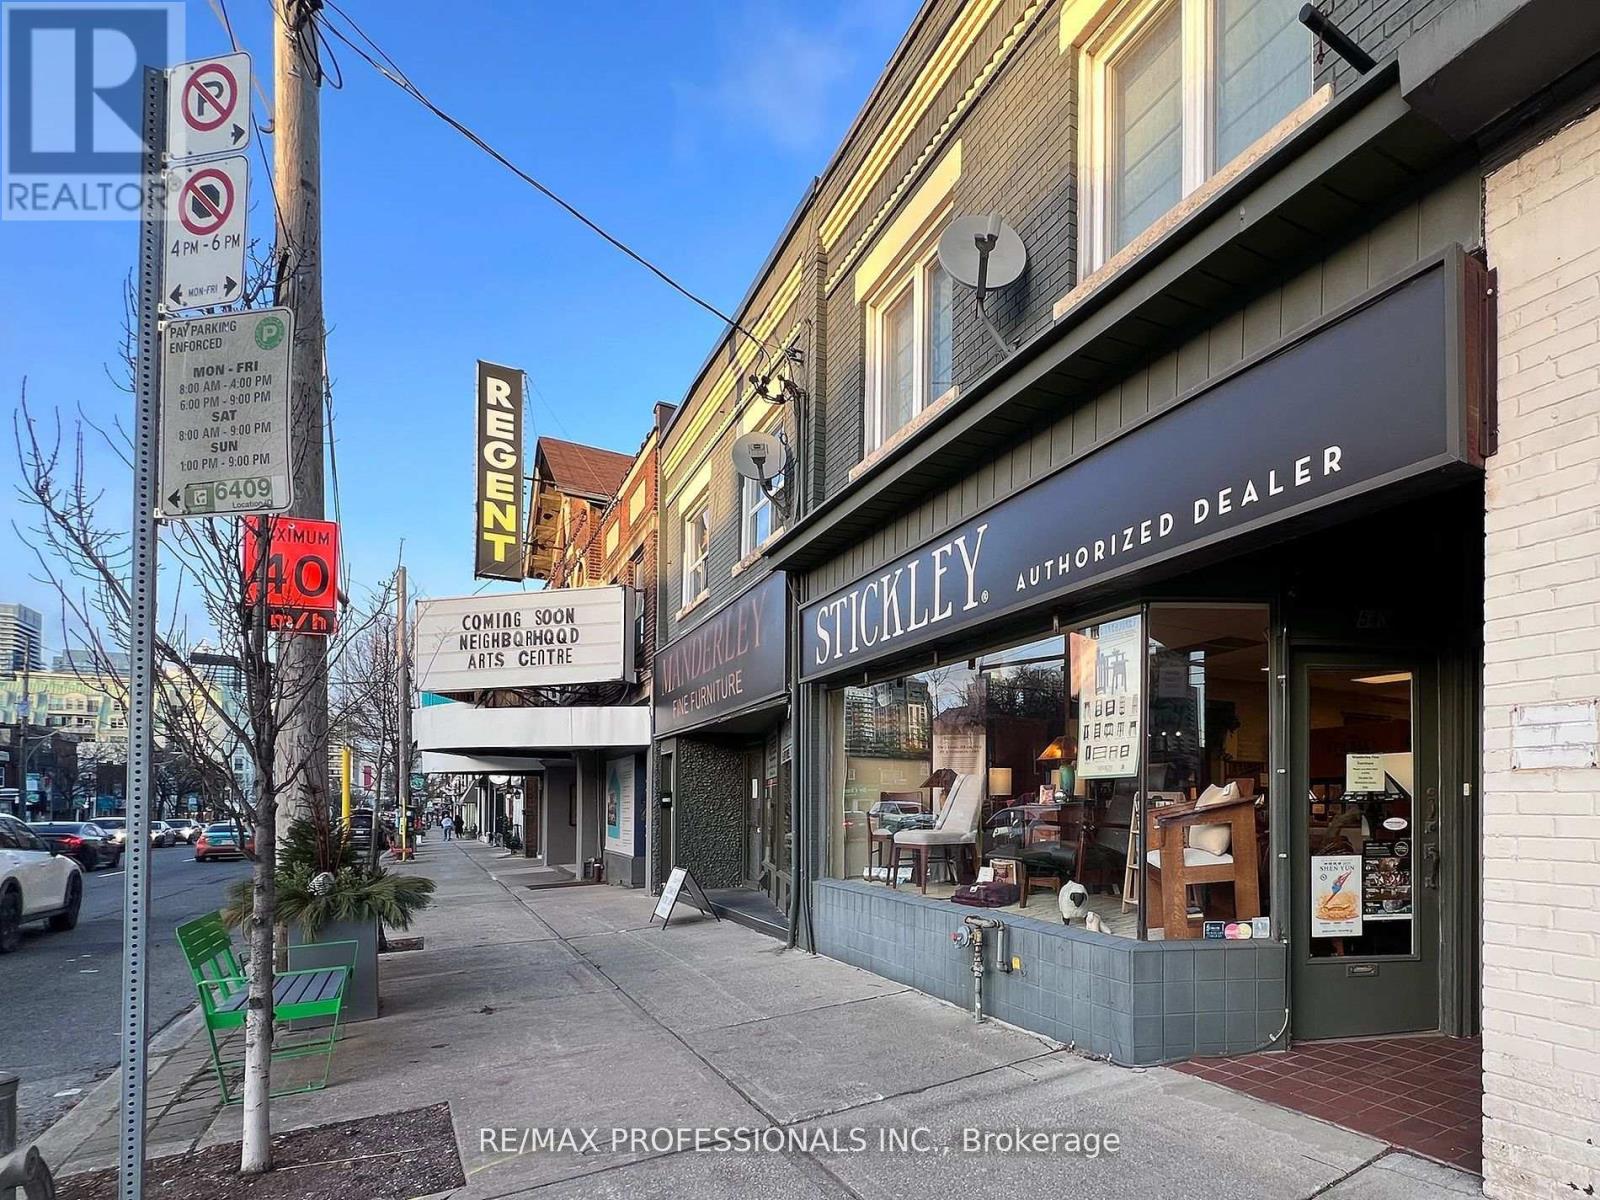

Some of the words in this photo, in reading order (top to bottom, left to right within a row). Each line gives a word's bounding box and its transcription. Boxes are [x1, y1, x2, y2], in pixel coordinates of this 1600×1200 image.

[183, 241, 199, 256] PM
[224, 234, 240, 248] PM
[170, 323, 189, 338] PAY
[191, 321, 237, 337] PARKING
[169, 338, 222, 354] ENFORCED
[193, 364, 224, 378] MON
[236, 361, 258, 372] FRI
[179, 382, 199, 395] 8:00
[203, 380, 220, 392] AM
[230, 376, 252, 389] 4:00
[255, 374, 272, 387] PM
[203, 396, 220, 408] PM
[230, 393, 251, 406] 9:00
[254, 391, 271, 403] PM
[212, 410, 237, 422] SAT
[179, 429, 199, 441] 8:00
[202, 427, 220, 439] AM
[230, 424, 251, 436] 9:00
[254, 422, 271, 434] PM
[210, 440, 238, 453] SUN
[180, 460, 198, 472] 1:00
[201, 458, 218, 470] PM
[228, 455, 249, 467] 9:00
[253, 453, 270, 465] PM
[483, 376, 517, 563] REGENT
[215, 478, 271, 500] 6409
[232, 500, 262, 509] Location
[1015, 512, 1175, 593] AUTHORIZED
[1193, 444, 1343, 525] DEALER
[270, 524, 330, 546] XIMUM
[535, 608, 575, 626] SOON
[661, 591, 767, 696] MANDERLEY
[468, 651, 505, 669] ARTS
[518, 647, 573, 667] CENTRE
[672, 694, 689, 720] FINE
[690, 670, 744, 712] FURNITURE
